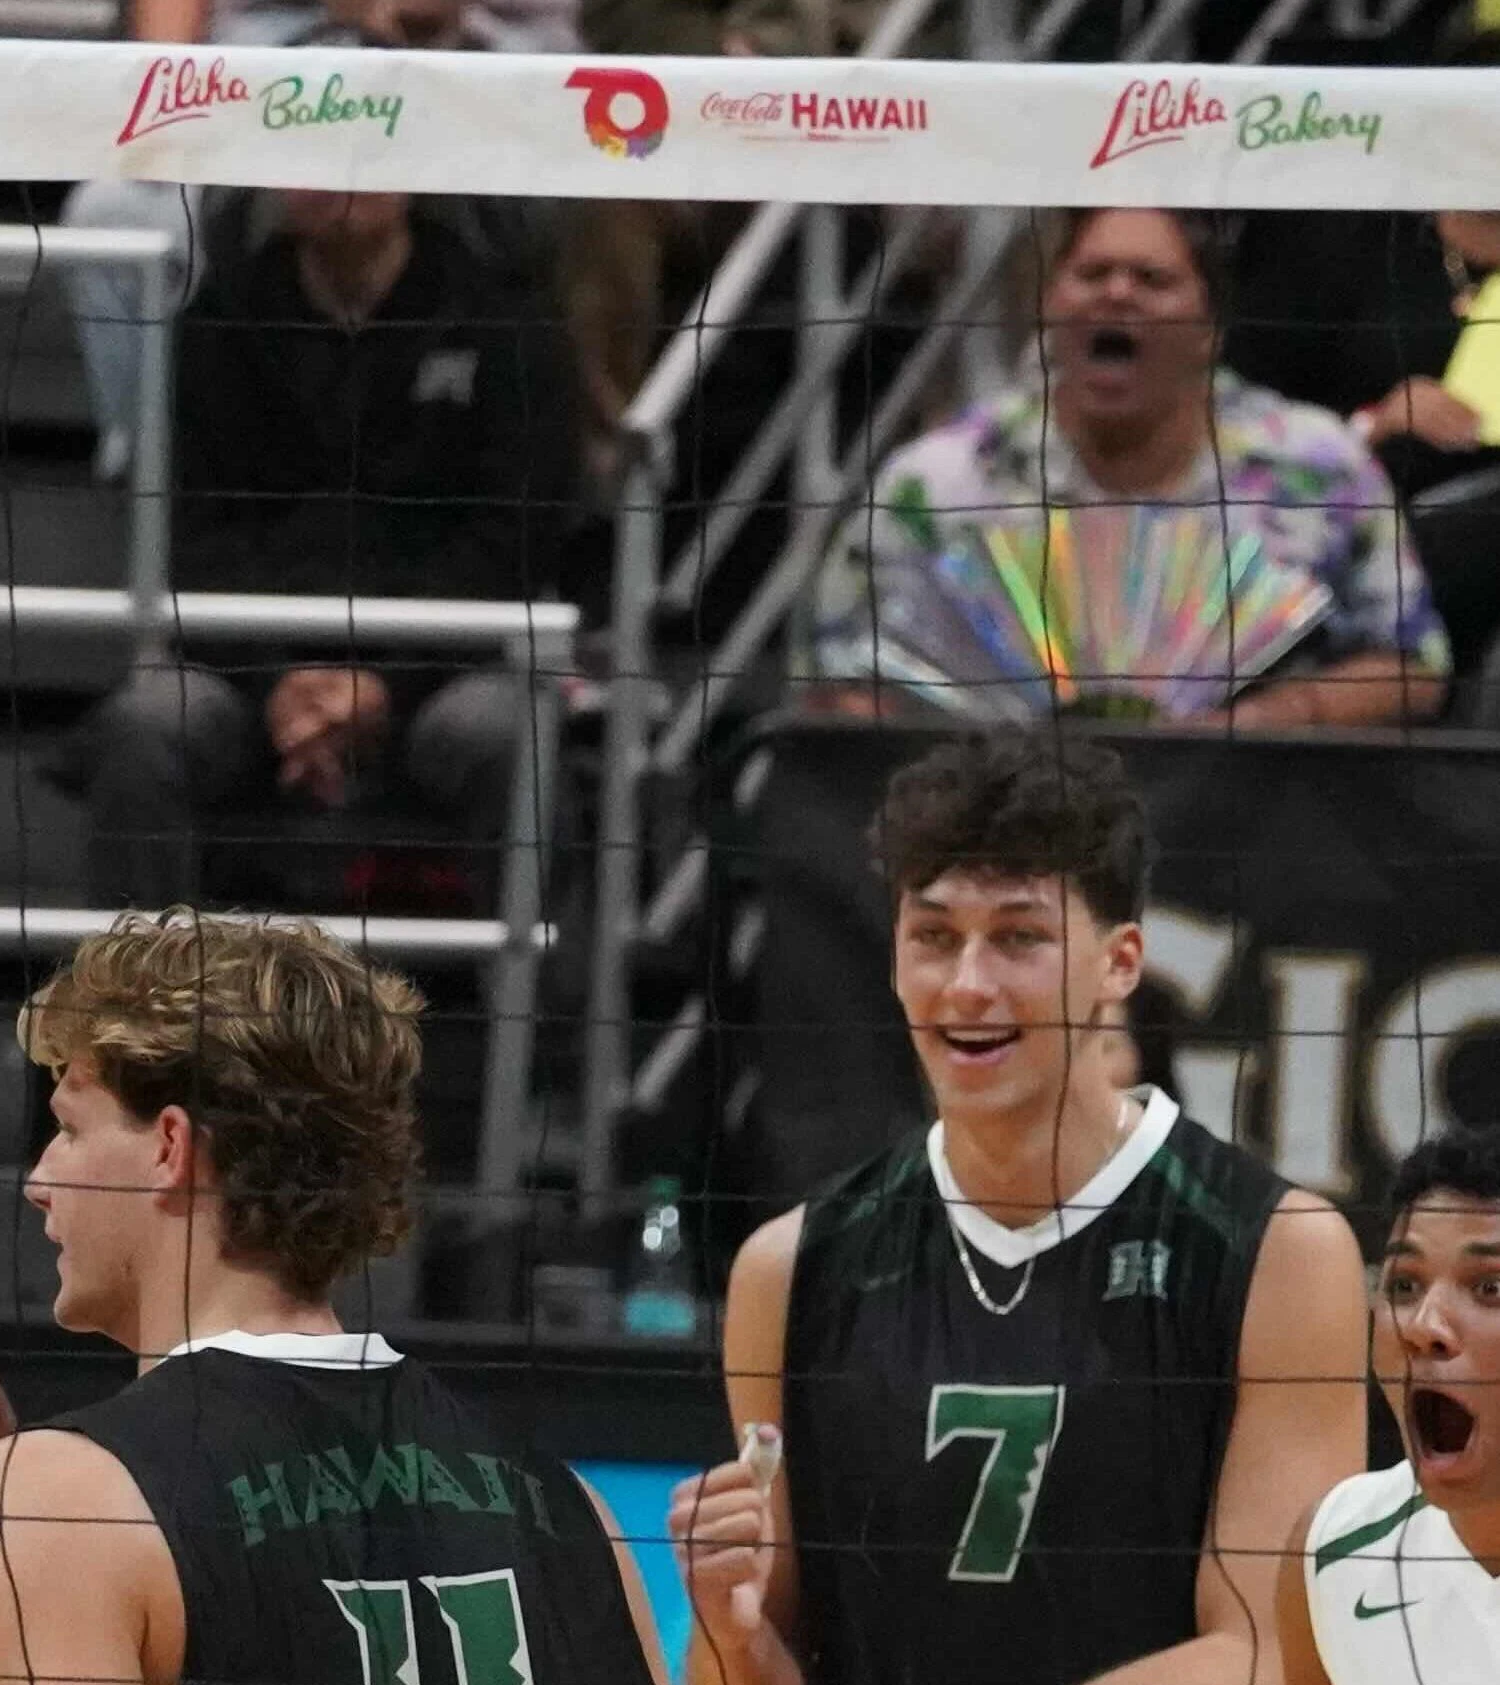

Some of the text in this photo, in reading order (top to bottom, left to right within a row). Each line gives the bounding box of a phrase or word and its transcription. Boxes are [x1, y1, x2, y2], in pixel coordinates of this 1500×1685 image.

[260, 73, 402, 138] Bakery
[791, 93, 927, 131] HAWAII
[1235, 91, 1381, 154] Bakery
[926, 1384, 1065, 1582] 7
